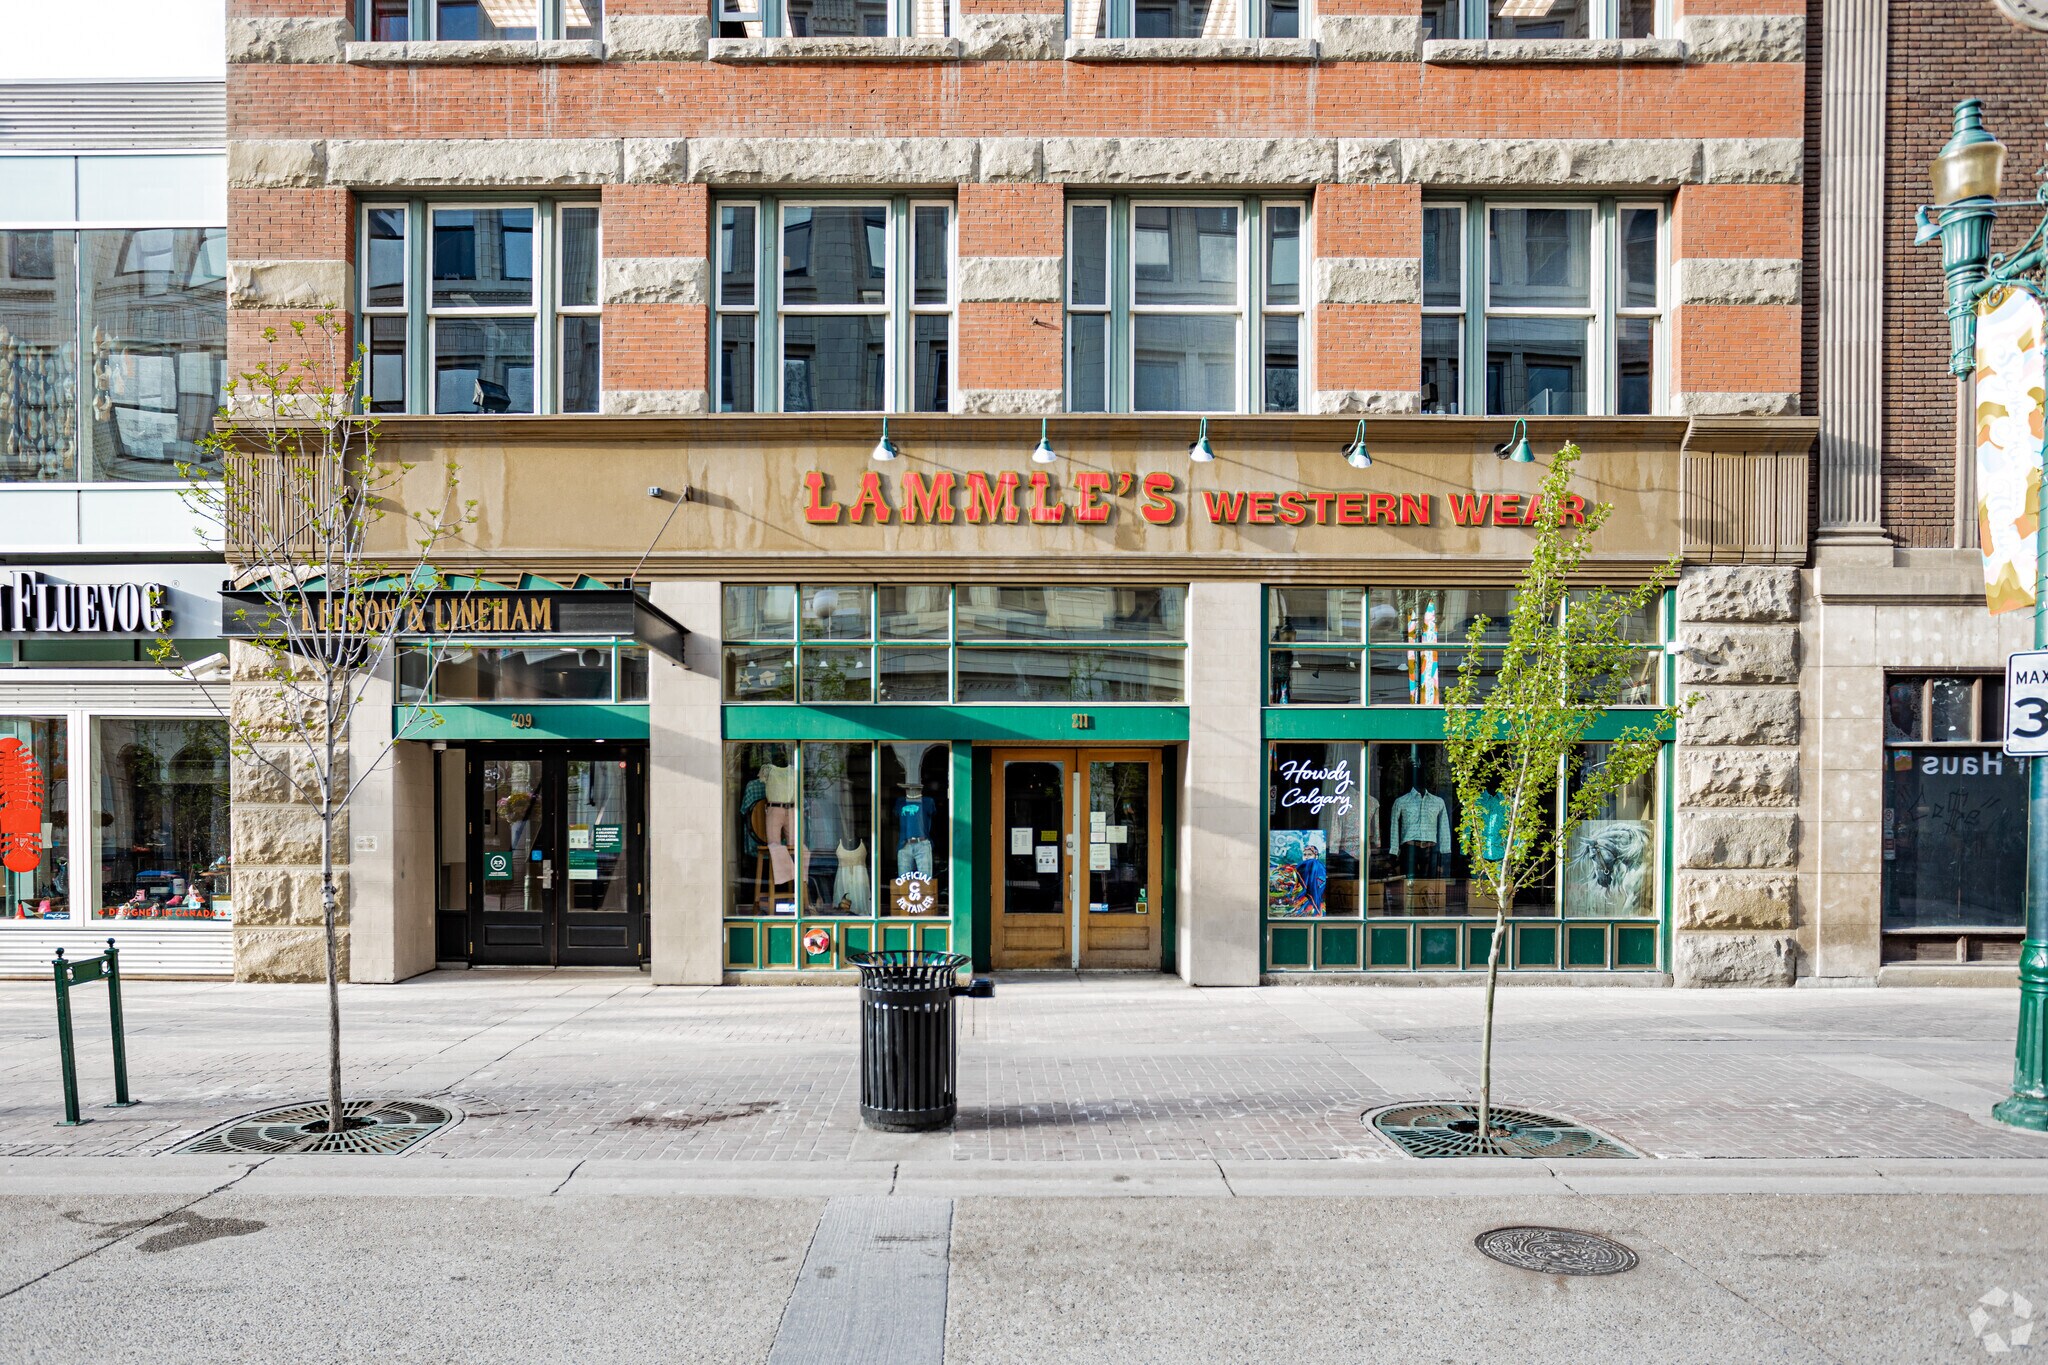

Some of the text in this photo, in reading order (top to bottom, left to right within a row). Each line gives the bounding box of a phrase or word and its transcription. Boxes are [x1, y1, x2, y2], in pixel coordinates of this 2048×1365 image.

[803, 471, 1177, 525] LAMMLE'S
[1201, 491, 1585, 525] WESTERN WEAR
[10, 571, 164, 632] FLUEVOG
[408, 598, 426, 631] &
[435, 598, 551, 631] LINEHAM
[511, 713, 532, 728] 209
[1071, 713, 1088, 728] 211
[1280, 759, 1354, 795] Howdy
[1281, 787, 1352, 815] Calgary
[895, 871, 932, 886] OFFICIAL
[109, 908, 217, 917] DESIGNED IN CANADA
[896, 895, 934, 913] RETAILER
